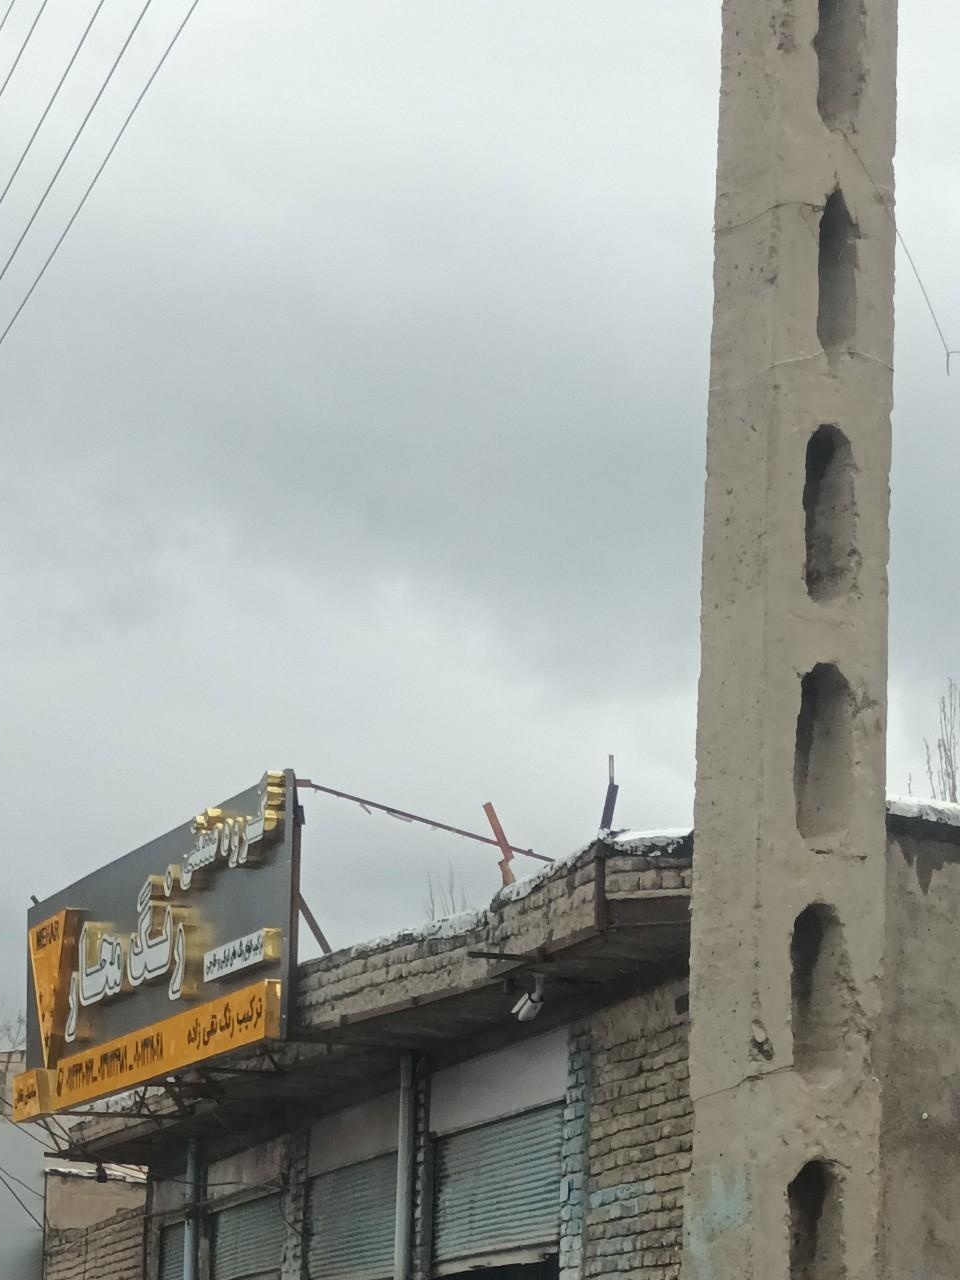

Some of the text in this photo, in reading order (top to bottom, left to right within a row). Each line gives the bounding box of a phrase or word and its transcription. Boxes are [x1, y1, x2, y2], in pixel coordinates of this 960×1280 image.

[127, 866, 185, 1001] رنگ
[219, 1001, 234, 1039] رنگ
[236, 995, 263, 1033] ترکیب
[187, 1017, 201, 1051] زاده
